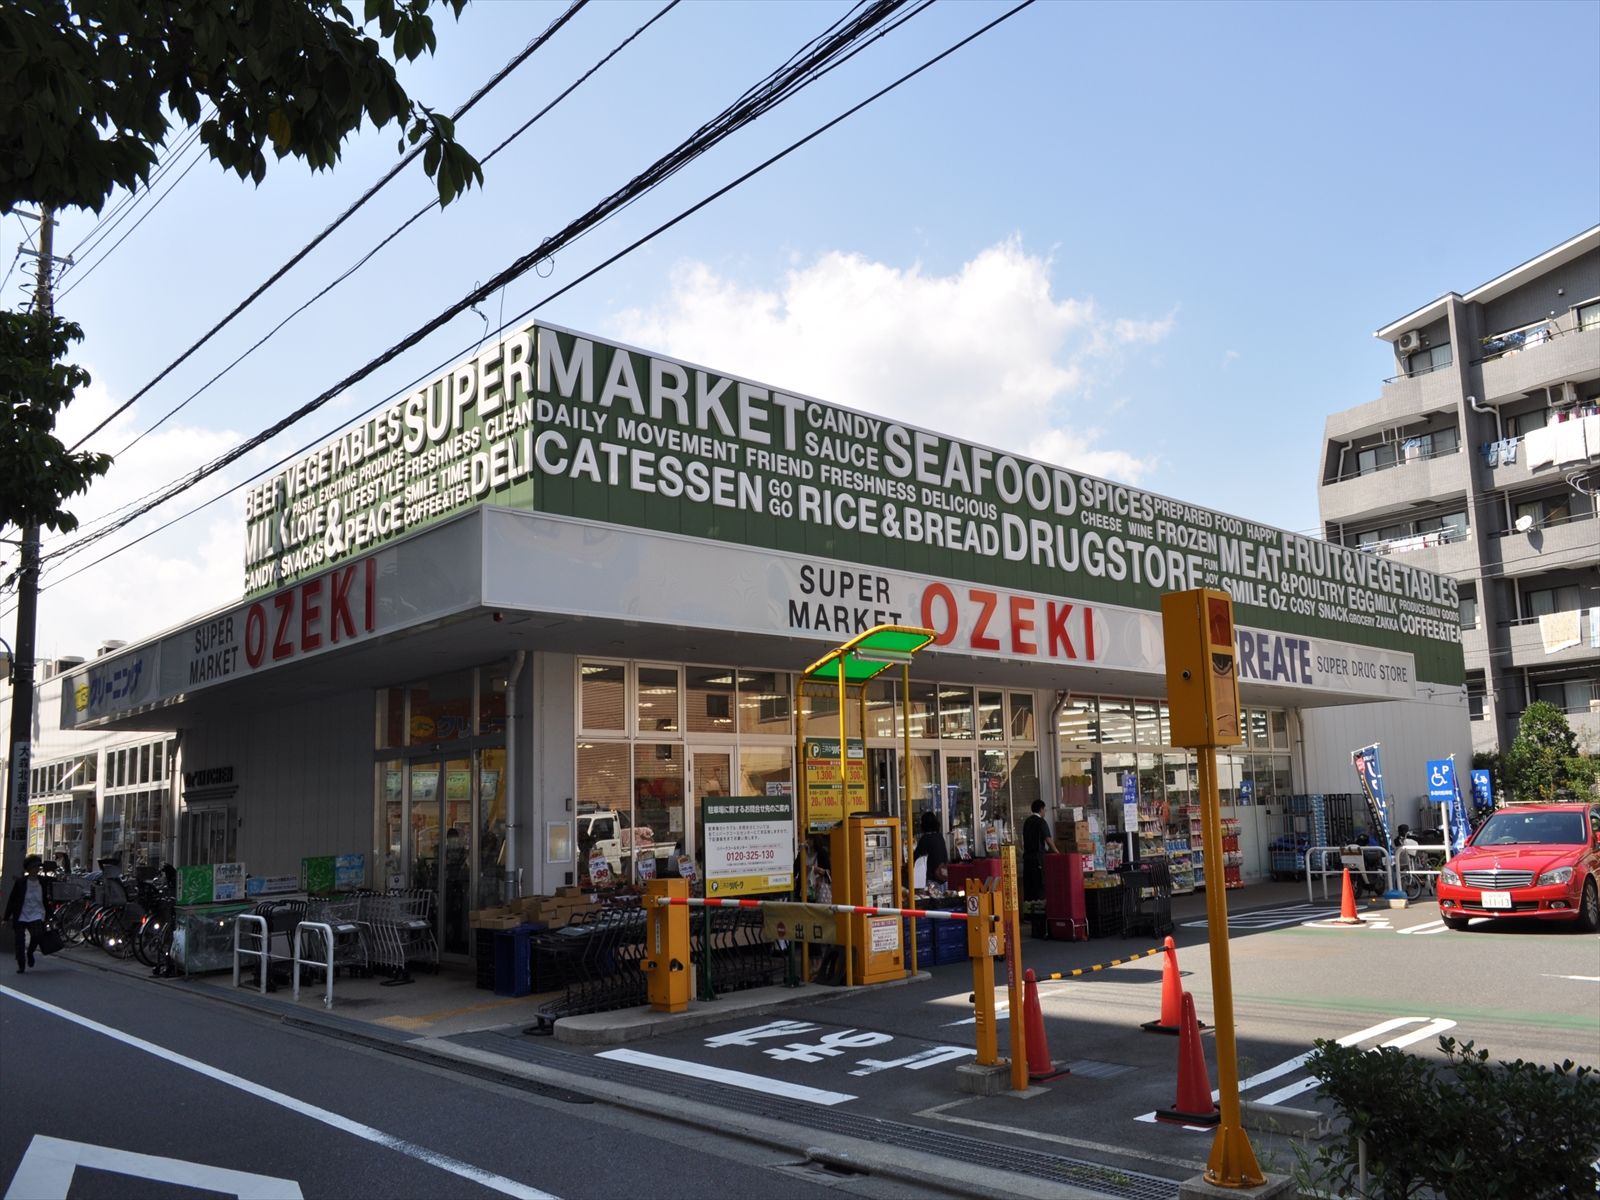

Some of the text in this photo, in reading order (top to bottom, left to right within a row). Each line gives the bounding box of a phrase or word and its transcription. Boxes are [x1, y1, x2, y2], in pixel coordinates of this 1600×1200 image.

[403, 331, 533, 454] SUPER
[537, 327, 806, 451] MARKET
[405, 399, 534, 481] FRESHNESS CLEAN
[807, 404, 881, 443] CANDY
[245, 405, 402, 522] BEEF VEGETABLES
[471, 428, 534, 496] DELI
[535, 430, 762, 513] CATESSEN
[536, 399, 997, 521] DAILY MOVEMENT FRIEND FRESHNESS DELICIOUS
[804, 432, 879, 471] SAUCE
[883, 424, 1077, 516] SEAFOOD
[293, 446, 406, 517] PASTA EXCITING PRODUCE
[345, 468, 406, 514] LIFESTYLE
[405, 460, 470, 505] SMILE TIME
[768, 479, 793, 499] GO
[1079, 477, 1154, 522] SPICES
[291, 507, 326, 542] LOVE
[345, 496, 405, 550] PEACE
[768, 498, 793, 518] GO
[1081, 511, 1153, 539] CHEESE WINE
[1154, 498, 1278, 545] PREPARED FOOD HAPPY
[245, 506, 291, 564] MILK
[1001, 512, 1203, 591] DRUGSTORE
[1156, 520, 1217, 555] FROZEN
[1203, 559, 1218, 572] FUN
[1205, 574, 1219, 585] JOY
[1219, 535, 1281, 584] MEAT
[799, 564, 891, 604] SUPER
[1221, 577, 1268, 608] SMILE
[1347, 587, 1375, 614] EGG
[1375, 593, 1398, 615] MILK
[244, 558, 376, 669] OZEKI
[920, 582, 1095, 661] OZEKI
[1290, 596, 1349, 624] COSY SNACK
[1349, 613, 1399, 631] GROCERY ZAKKA
[1399, 600, 1459, 621] PRODUCE DAILY GOODS
[194, 616, 234, 654] SUPER
[1235, 630, 1312, 684] REATE
[89, 658, 142, 707] クリーニング
[189, 646, 239, 686] MARKET
[1317, 655, 1408, 683] SUPER DRUG STORE
[1442, 765, 1450, 775] P
[726, 849, 775, 862] 0120-325-130
[795, 923, 823, 939] 出口
